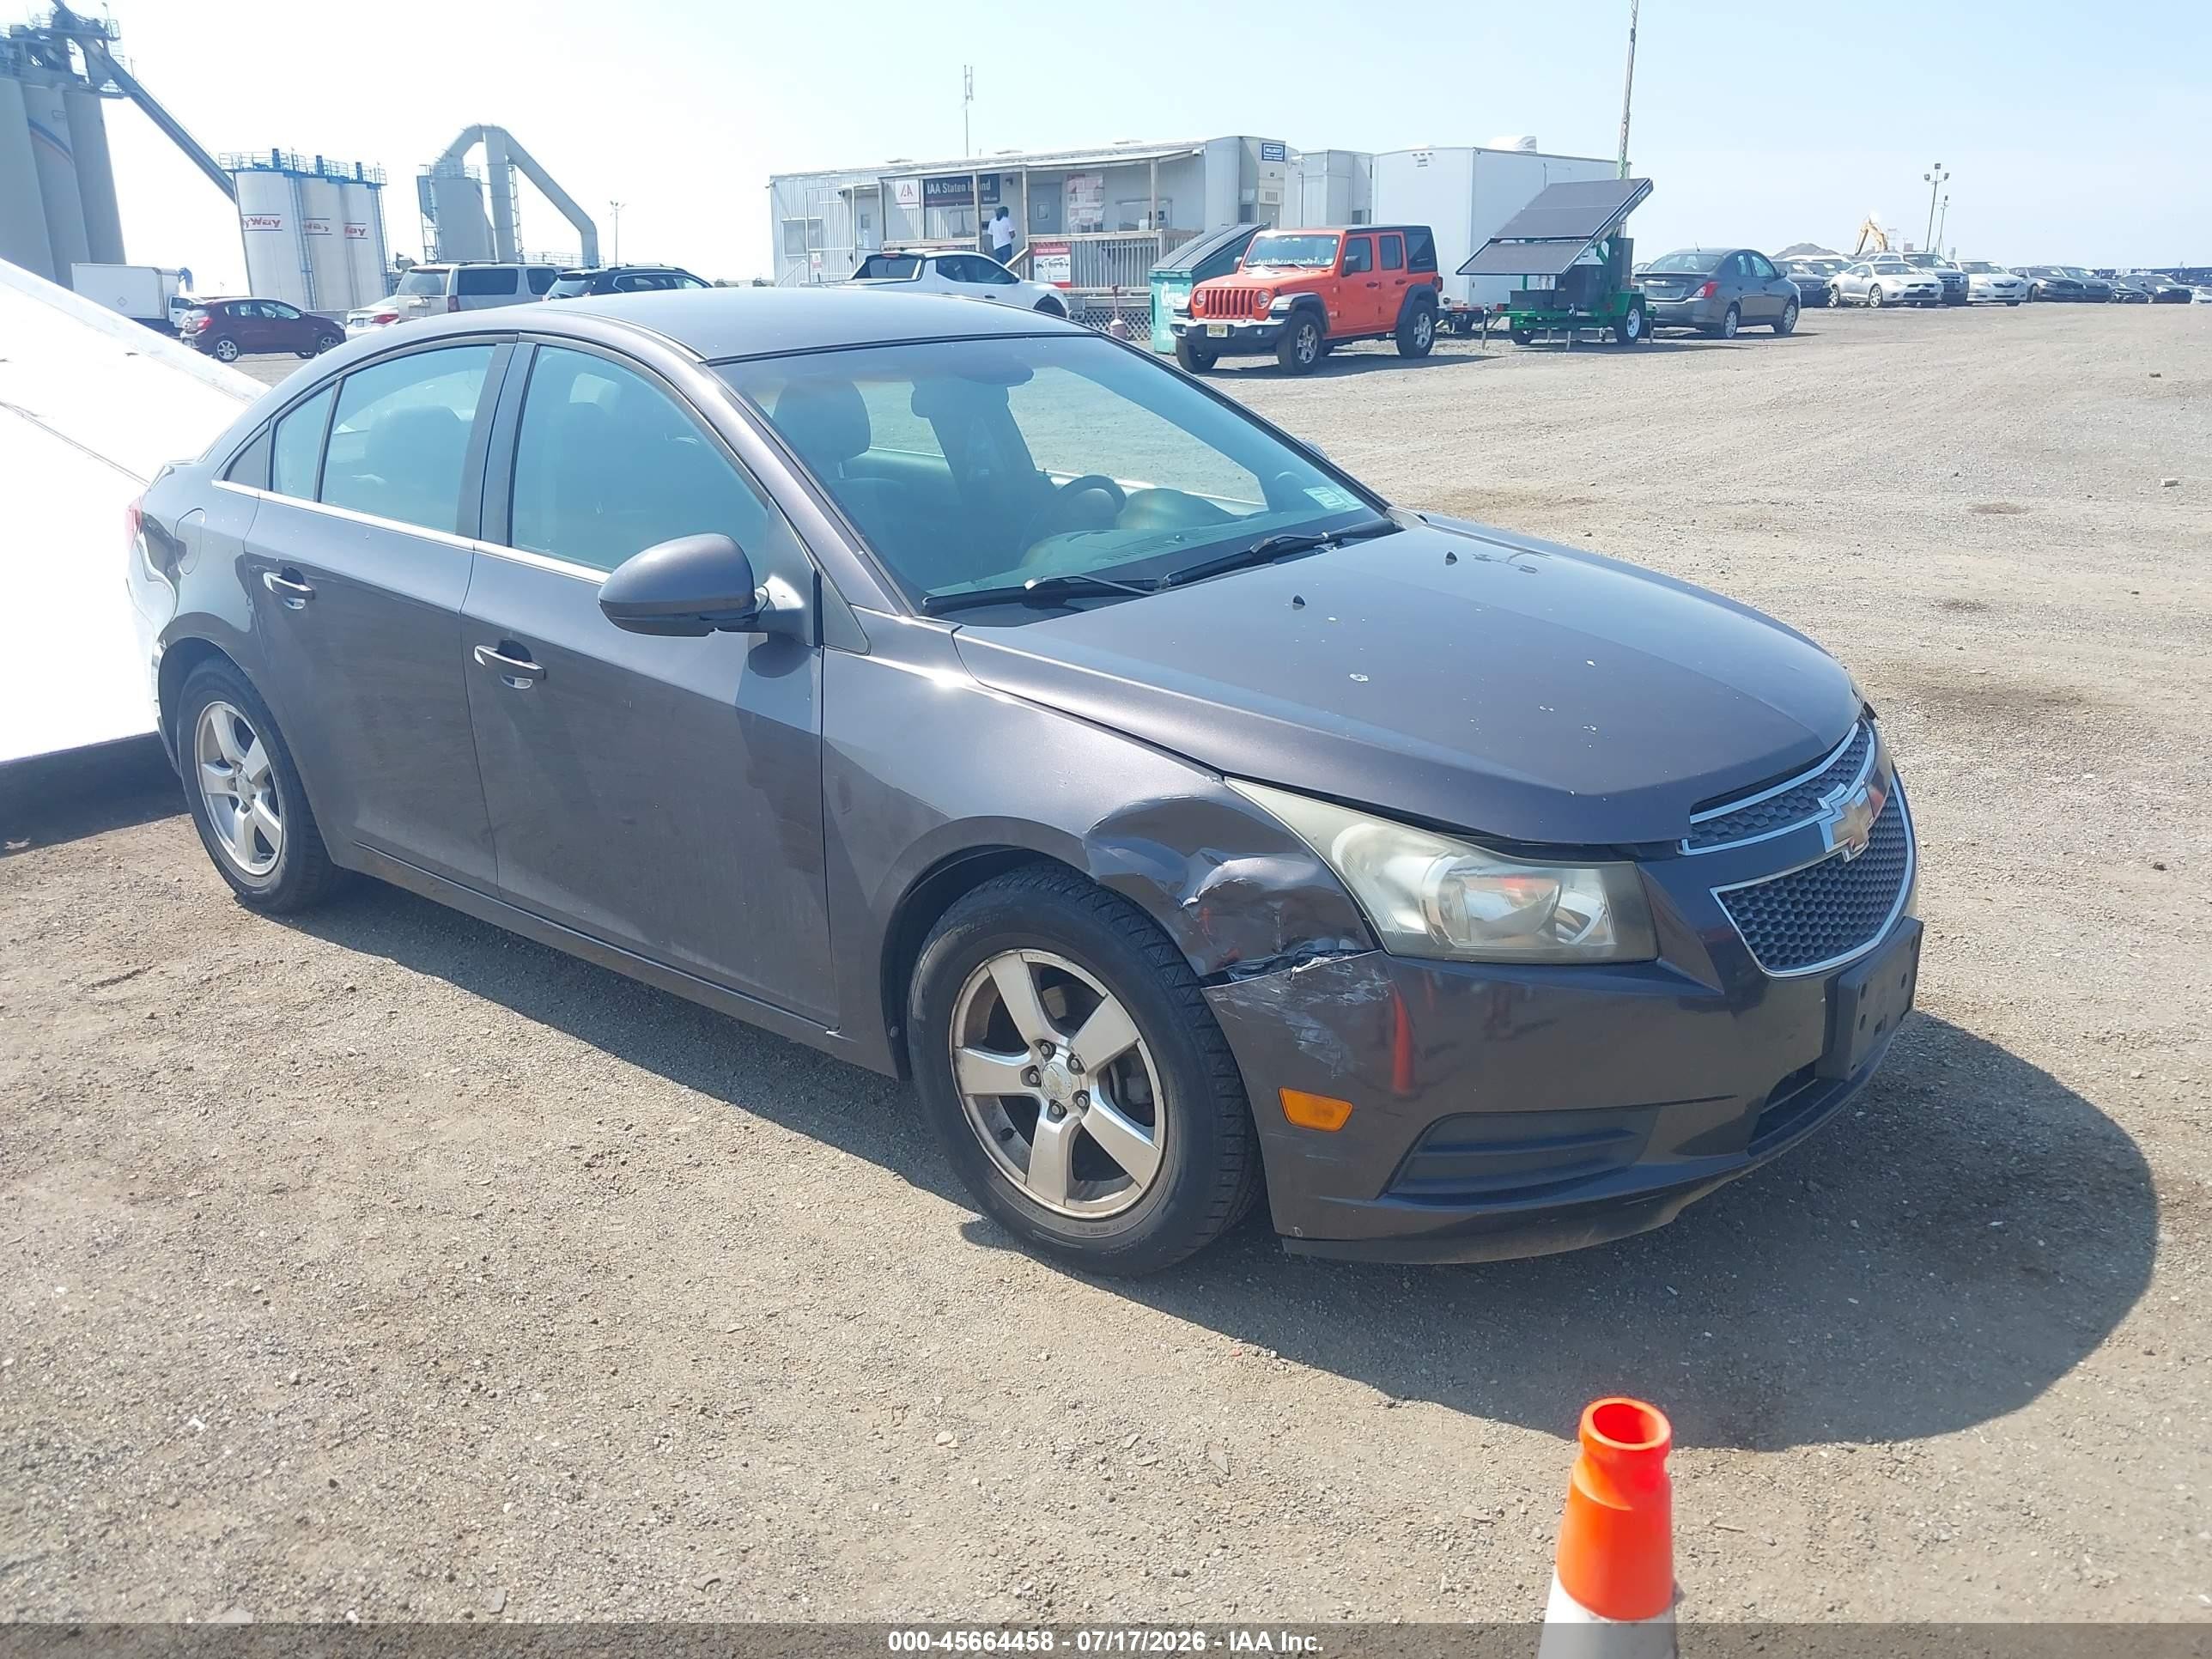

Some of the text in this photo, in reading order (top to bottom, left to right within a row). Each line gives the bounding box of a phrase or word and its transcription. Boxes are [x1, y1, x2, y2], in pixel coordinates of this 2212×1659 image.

[927, 178, 991, 194] IAA Staten Isnd
